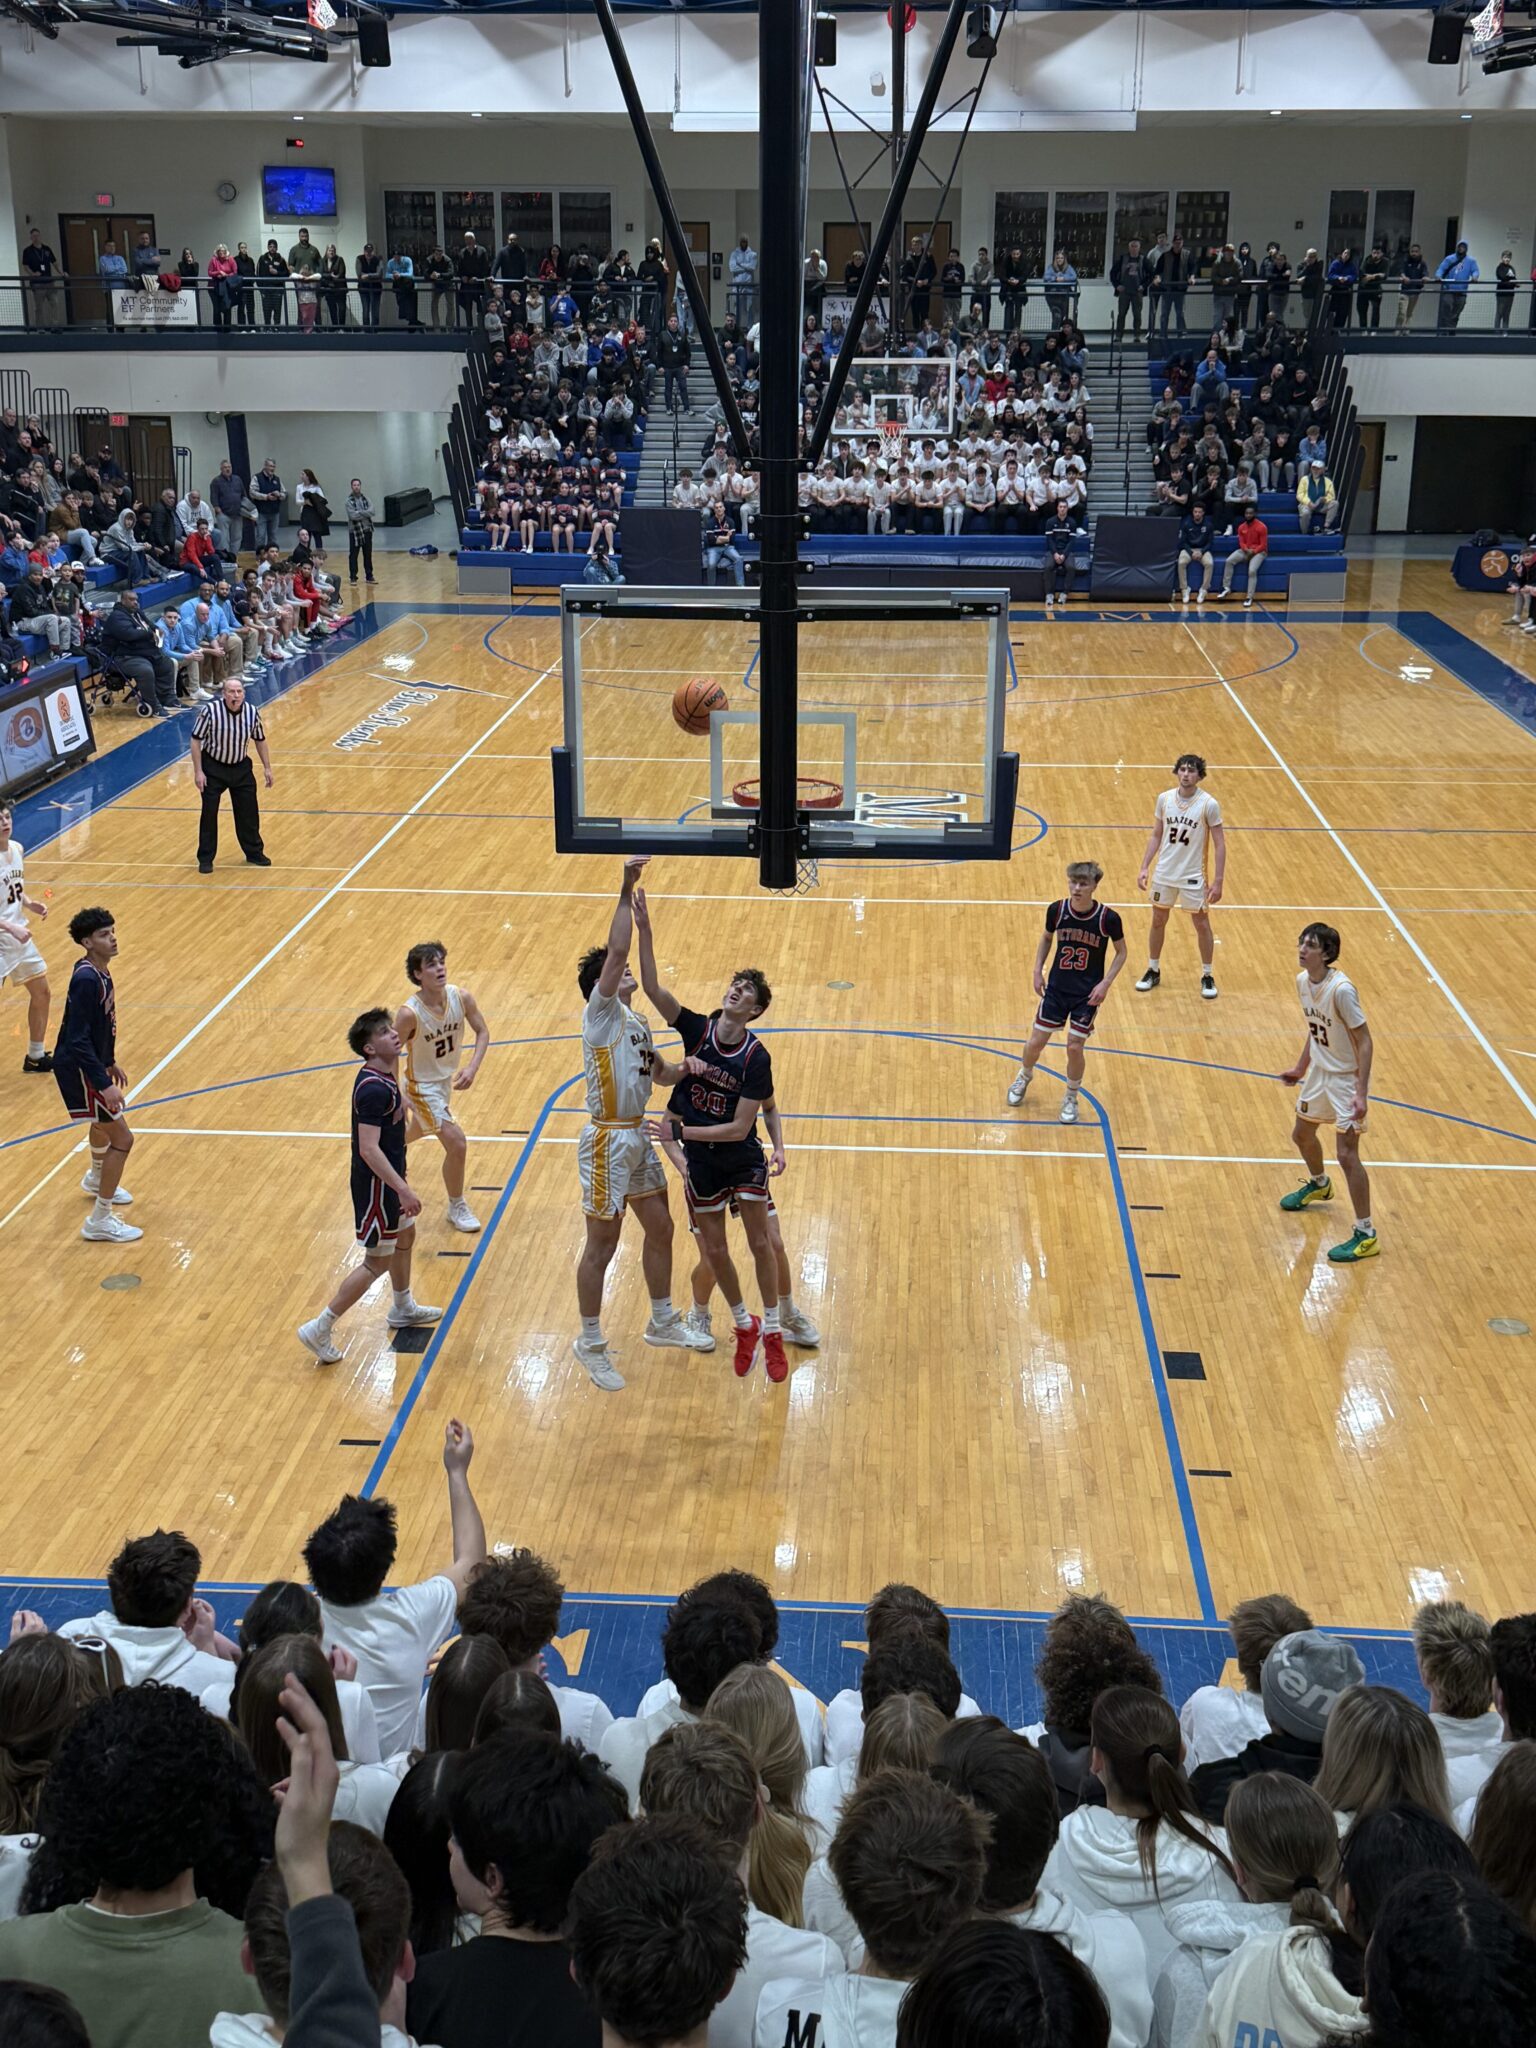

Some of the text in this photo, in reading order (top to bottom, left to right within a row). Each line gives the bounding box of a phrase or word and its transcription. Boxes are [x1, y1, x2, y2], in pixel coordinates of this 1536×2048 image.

[120, 296, 188, 307] MT Community
[140, 305, 175, 313] Partners
[1166, 816, 1198, 830] BLAZERS
[1169, 827, 1189, 847] 24
[1060, 946, 1089, 970] 23
[435, 1035, 455, 1059] 21
[690, 1083, 727, 1117] 20
